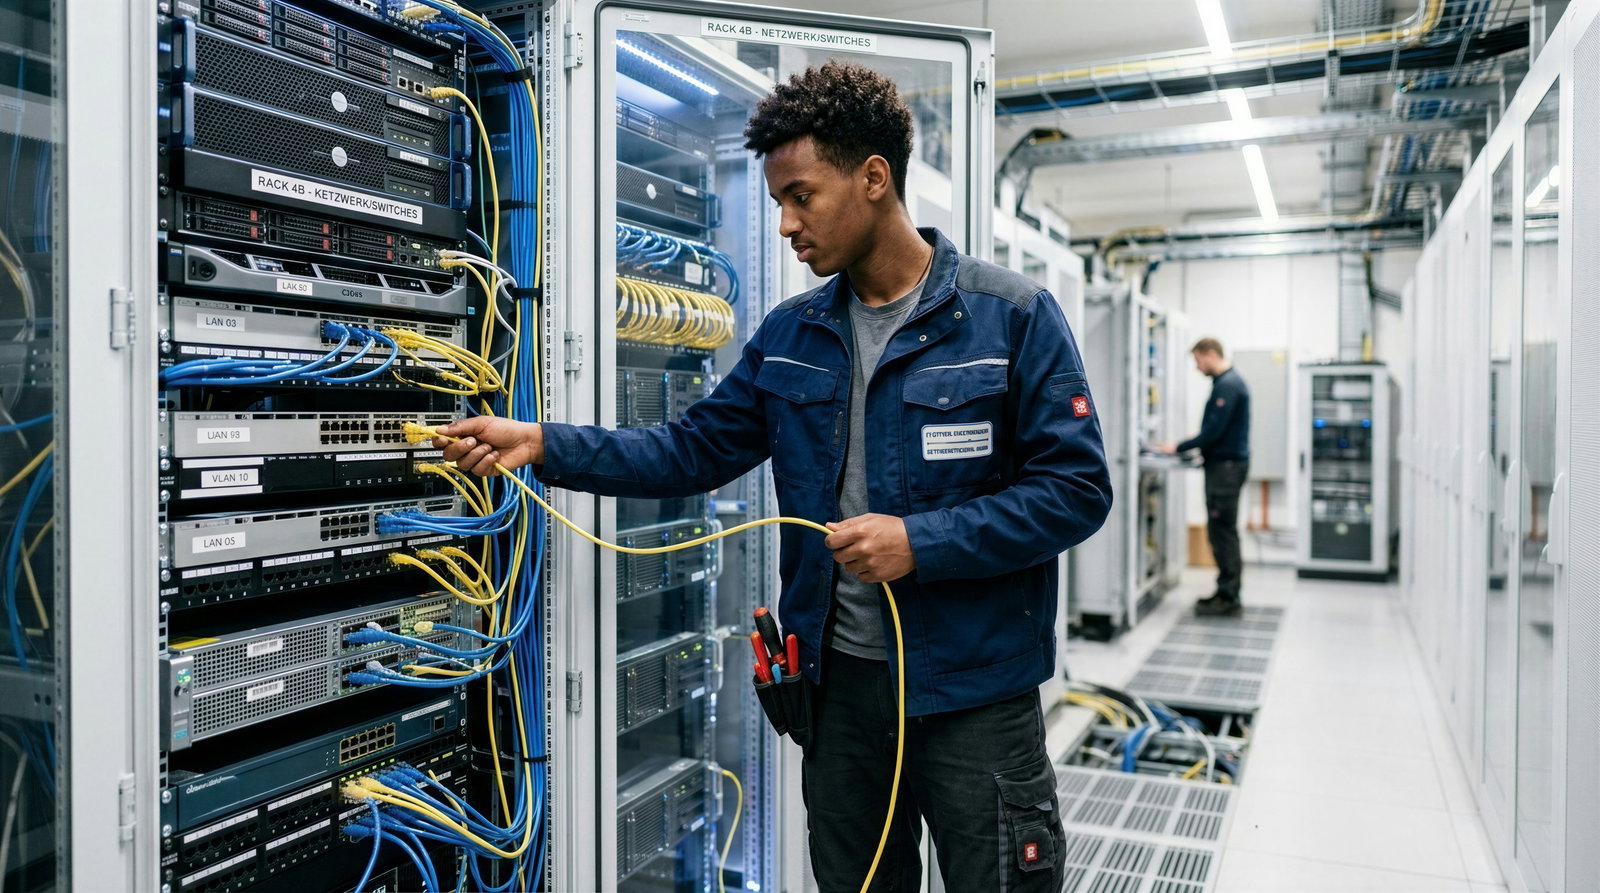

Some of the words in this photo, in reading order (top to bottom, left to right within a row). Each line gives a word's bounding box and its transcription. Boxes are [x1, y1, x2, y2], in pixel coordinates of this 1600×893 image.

[707, 22, 736, 34] RACK
[739, 25, 752, 35] 4B
[258, 176, 289, 191] RACK
[291, 183, 305, 195] 4B
[205, 316, 224, 326] LAN
[212, 473, 236, 483] VLAN
[239, 472, 249, 482] 10
[203, 537, 222, 548] LAN
